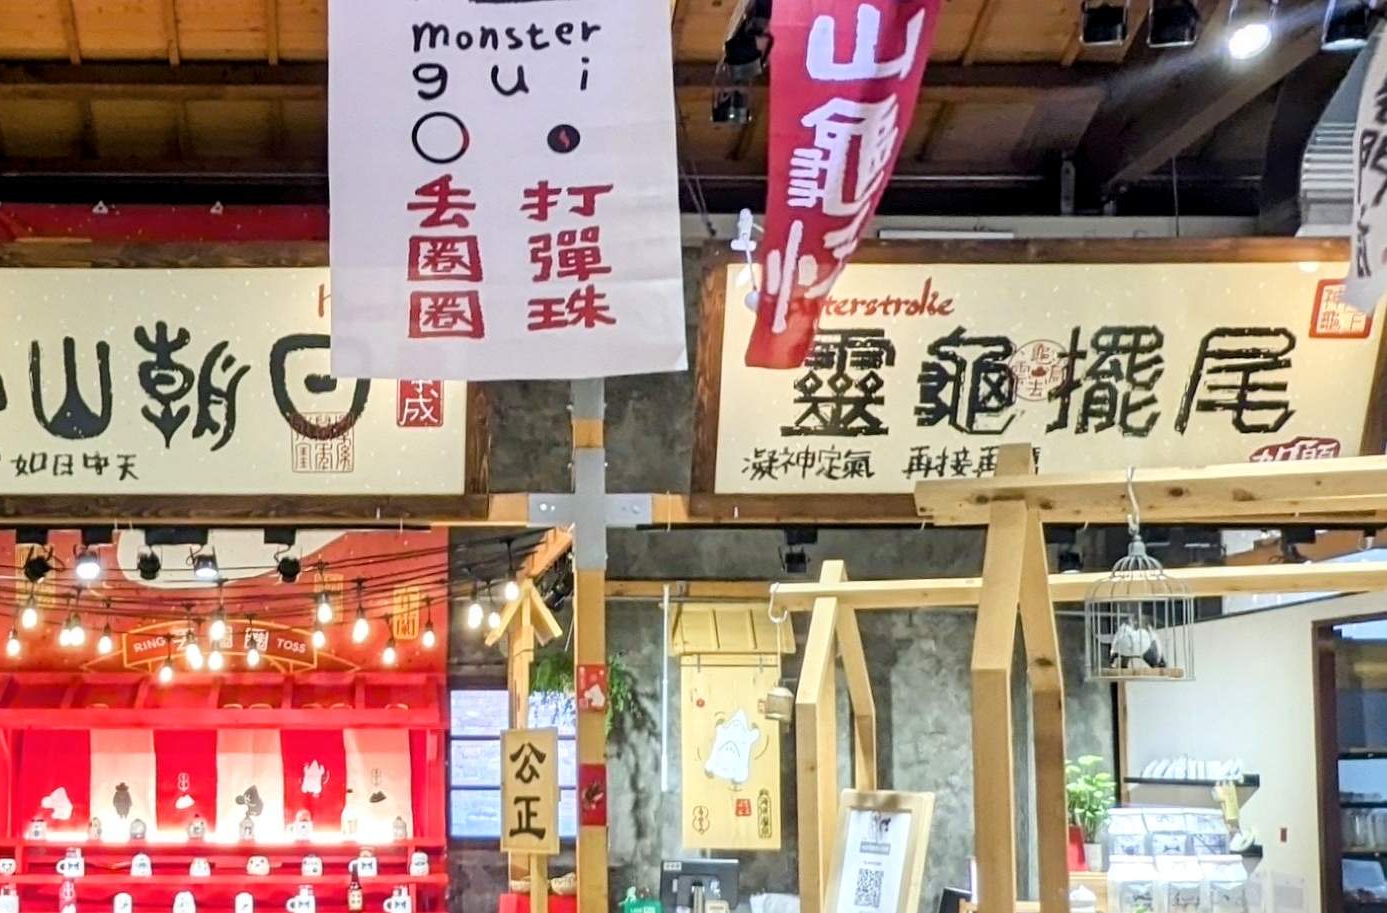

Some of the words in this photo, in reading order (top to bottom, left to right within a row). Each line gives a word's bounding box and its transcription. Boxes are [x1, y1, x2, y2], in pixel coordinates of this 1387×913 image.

[412, 20, 602, 52] monster
[520, 179, 617, 332] 打彈珠
[780, 324, 1297, 438] 靈龜擺尾
[10, 450, 140, 483] 如日中天
[741, 444, 875, 481] 凝神定氣
[902, 445, 1042, 479] 再接再
[133, 636, 167, 653] RING
[276, 637, 307, 654] TOSS
[510, 741, 547, 841] 公正
